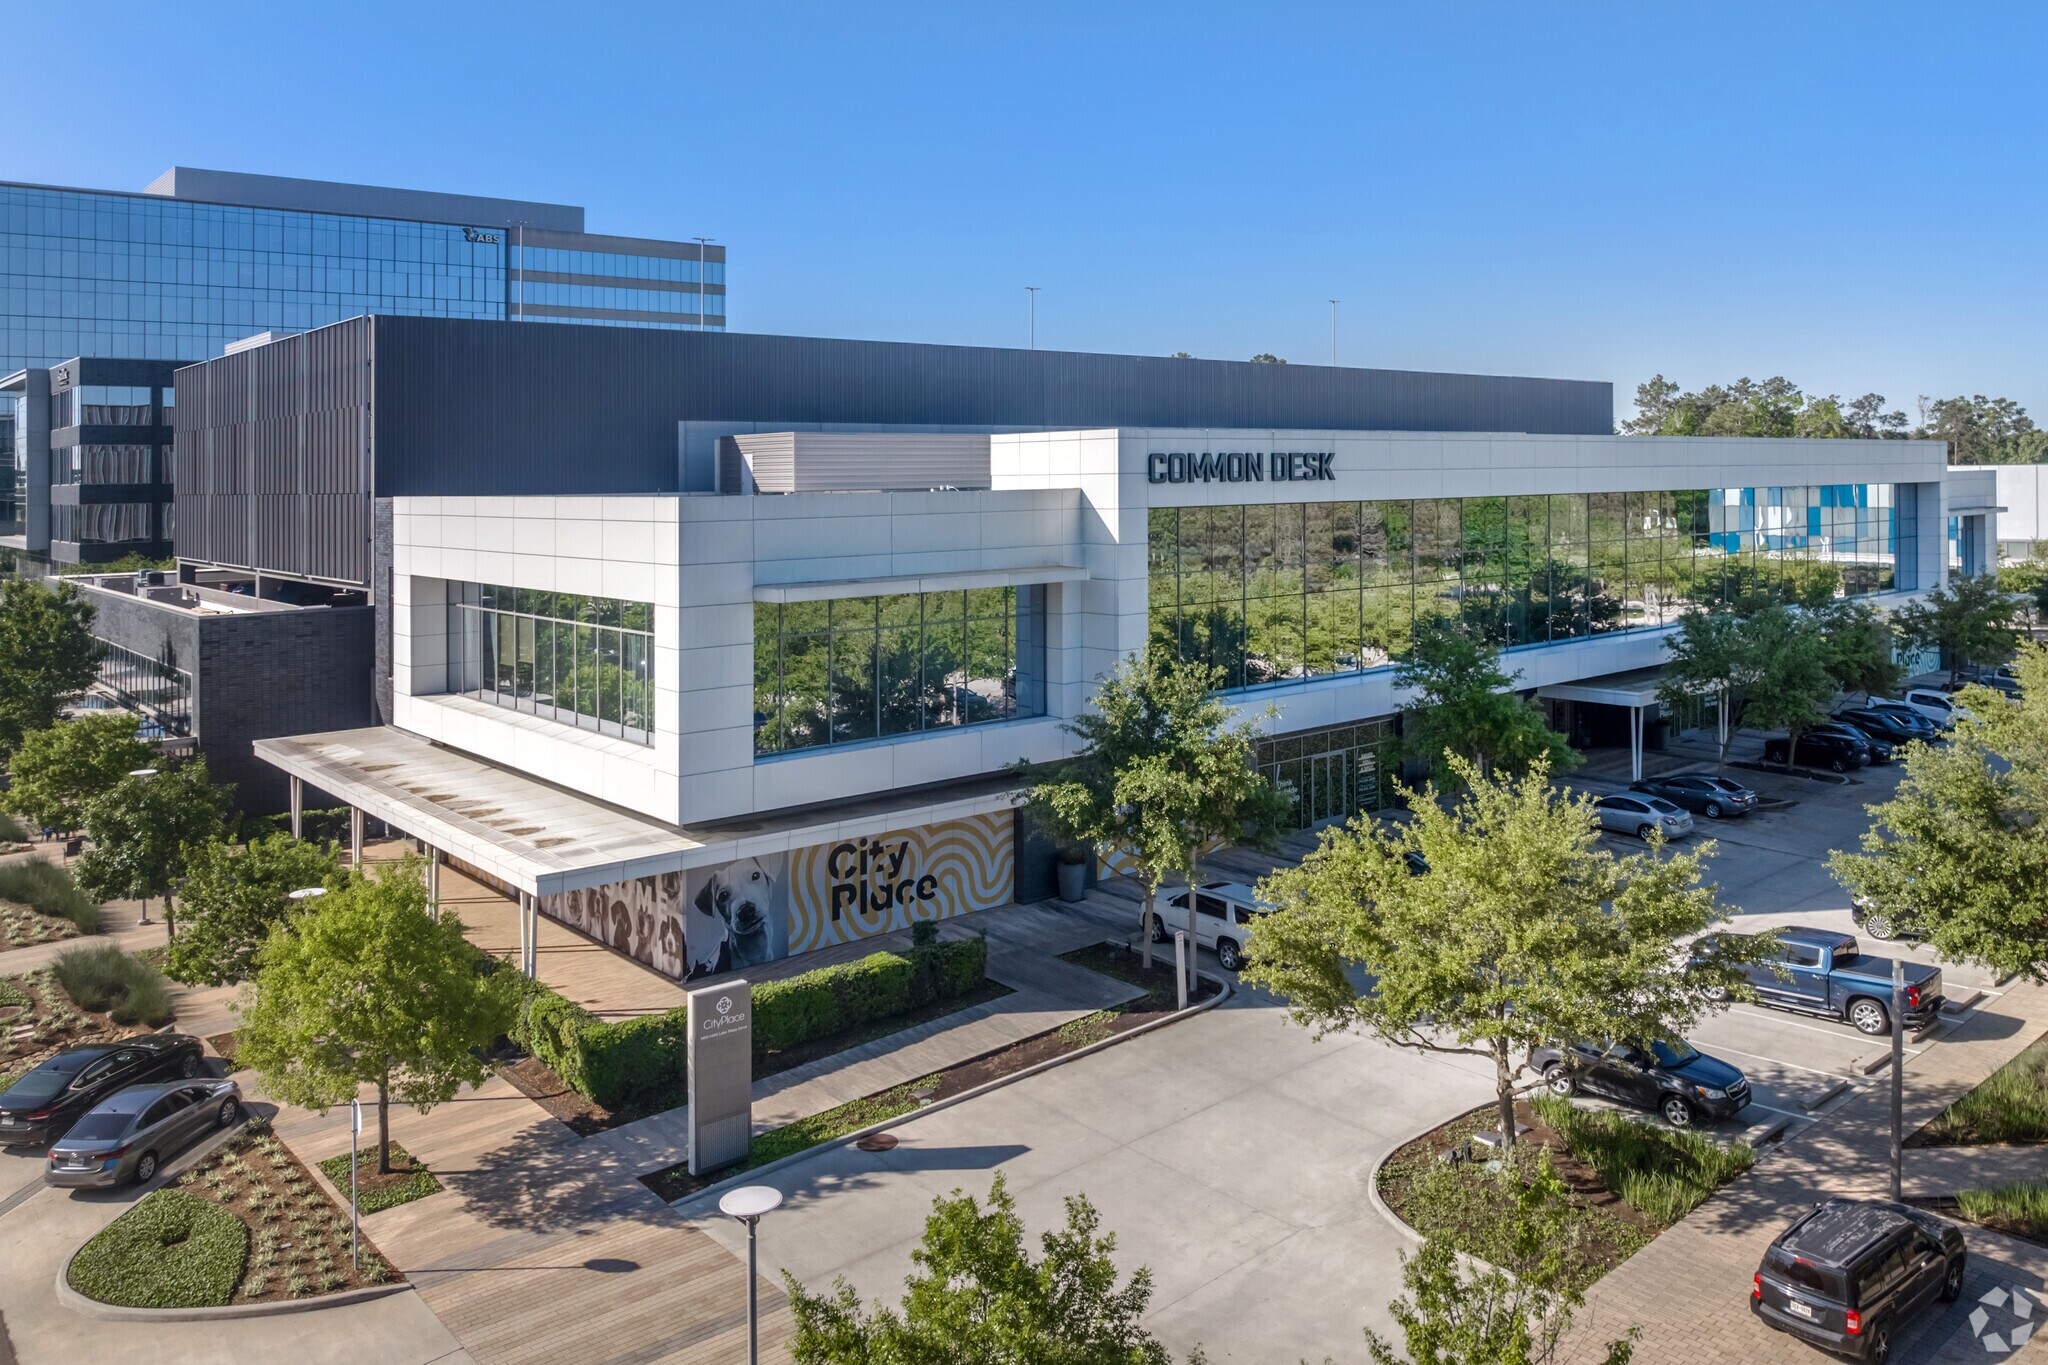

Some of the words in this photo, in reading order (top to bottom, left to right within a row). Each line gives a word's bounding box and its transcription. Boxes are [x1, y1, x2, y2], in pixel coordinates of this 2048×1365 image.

[476, 233, 500, 244] ABS
[1148, 452, 1264, 484] COMMON
[1270, 452, 1336, 482] DESK
[828, 838, 909, 880] City
[832, 874, 938, 921] Place
